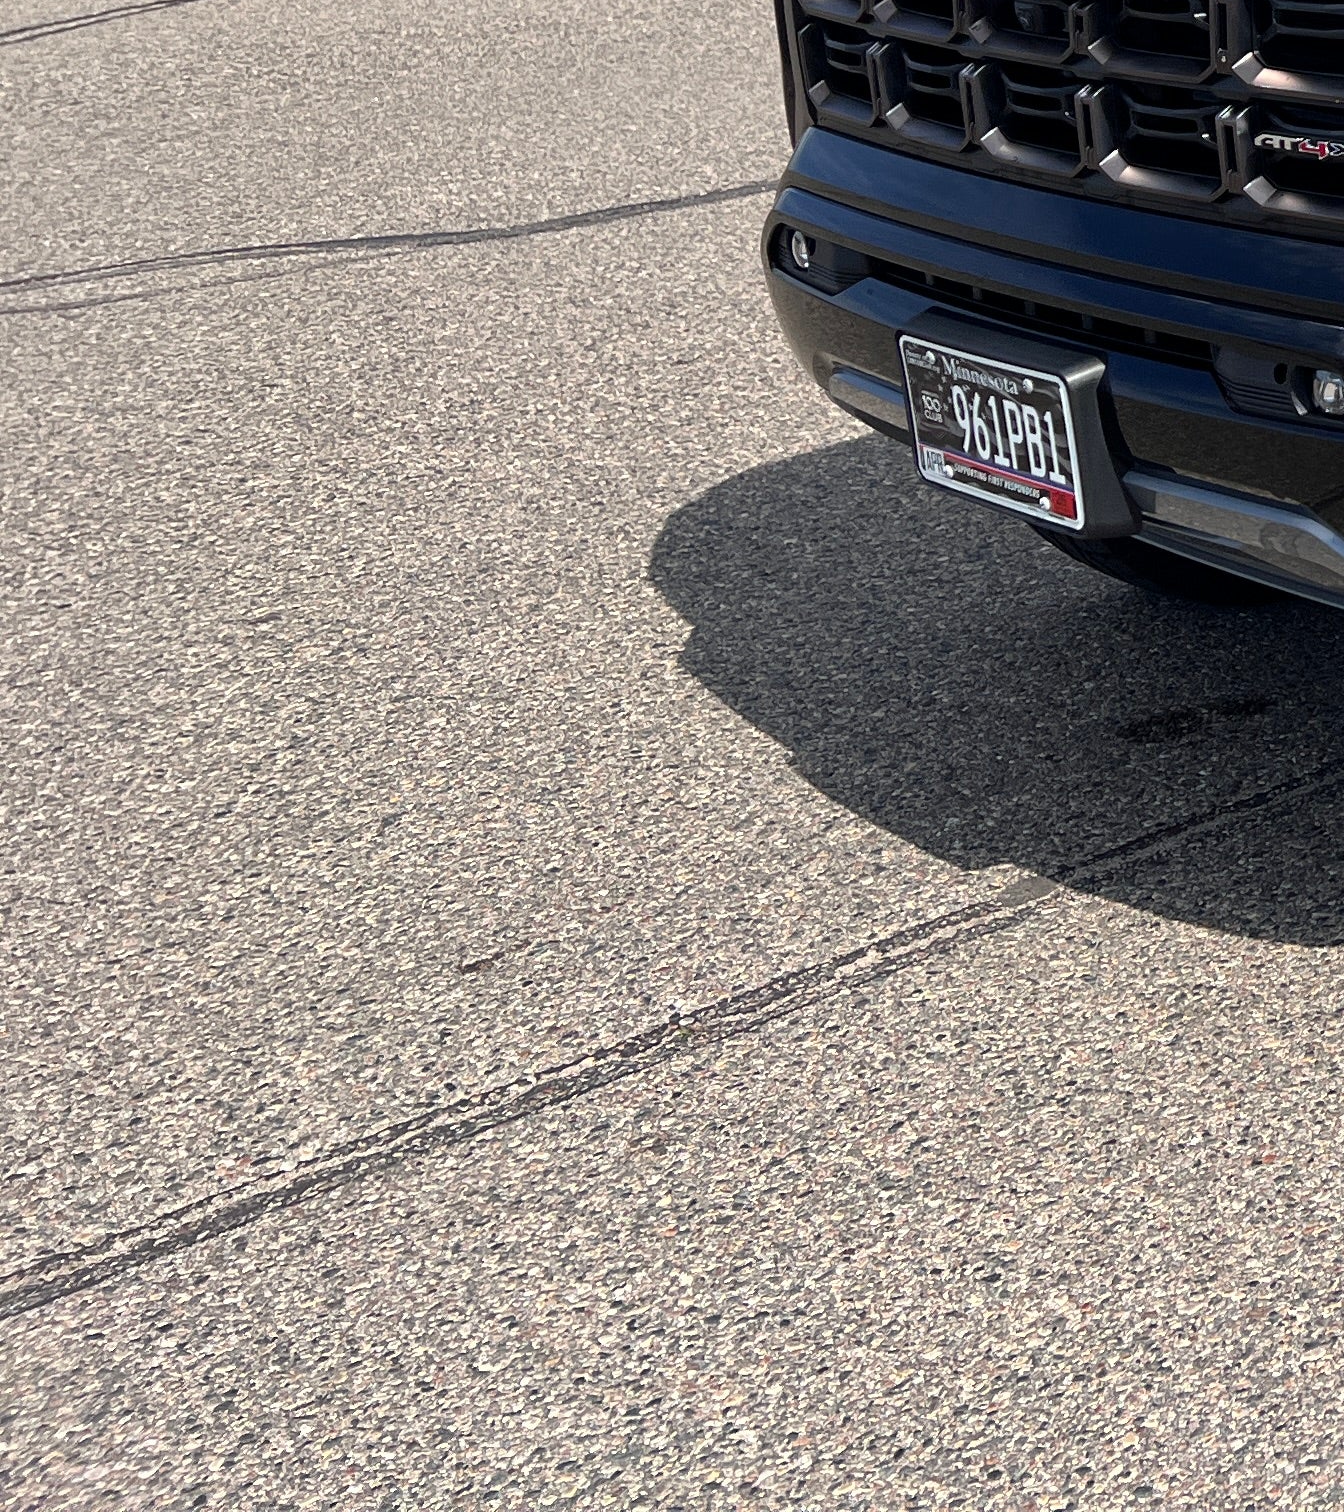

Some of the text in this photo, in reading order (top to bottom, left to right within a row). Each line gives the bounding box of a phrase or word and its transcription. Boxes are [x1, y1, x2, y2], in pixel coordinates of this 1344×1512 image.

[941, 355, 1019, 395] Minnesota
[952, 385, 1067, 485] 961PB1
[953, 462, 988, 482] SUPPORTING
[987, 474, 1004, 487] FIRST
